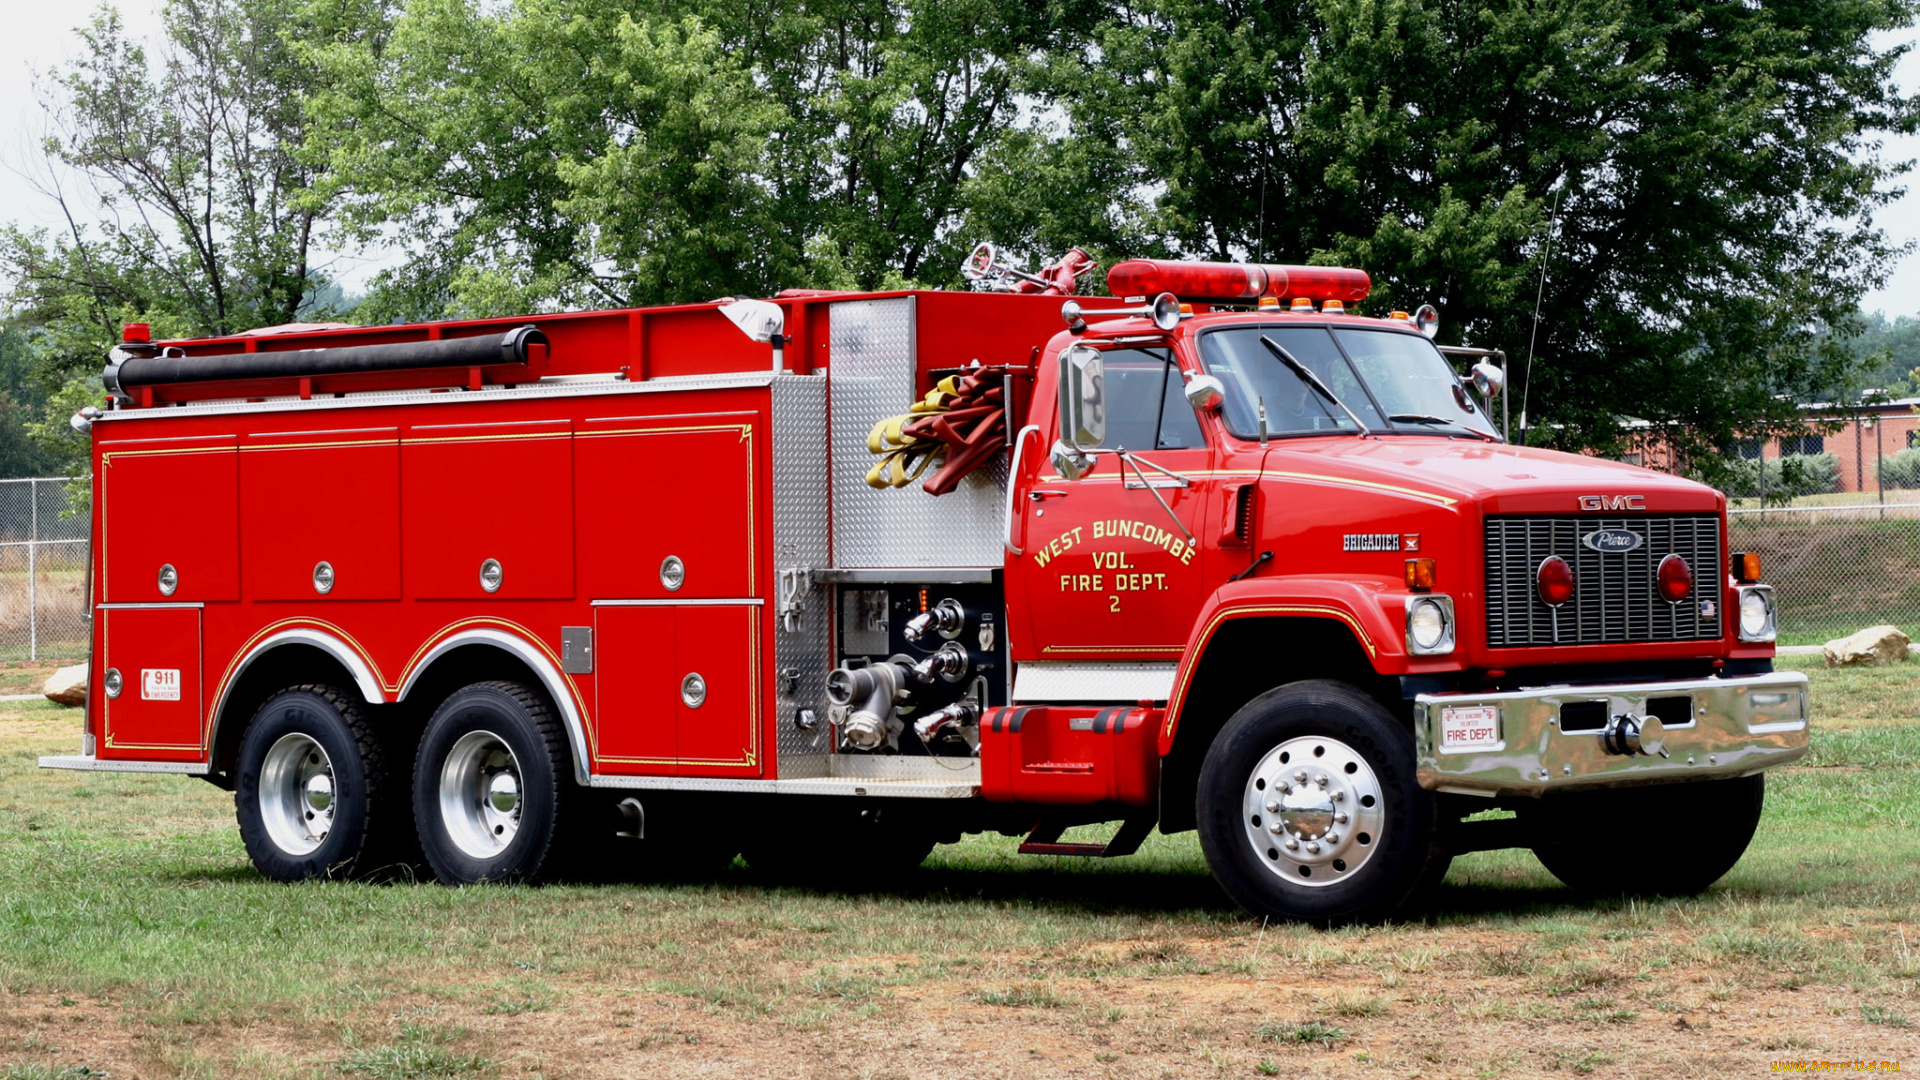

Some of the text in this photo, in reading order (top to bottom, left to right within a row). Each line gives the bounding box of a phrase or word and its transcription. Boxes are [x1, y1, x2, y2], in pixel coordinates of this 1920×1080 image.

[1578, 495, 1646, 510] GMC
[1034, 519, 1196, 568] WEST BUNCOMBE
[1343, 533, 1400, 551] BRIGADIER
[1597, 532, 1631, 548] Pierce
[1092, 551, 1134, 569] VOL.
[1060, 573, 1169, 591] FIRE DEPT.
[1109, 595, 1121, 613] 2
[1447, 729, 1467, 741] FIRE
